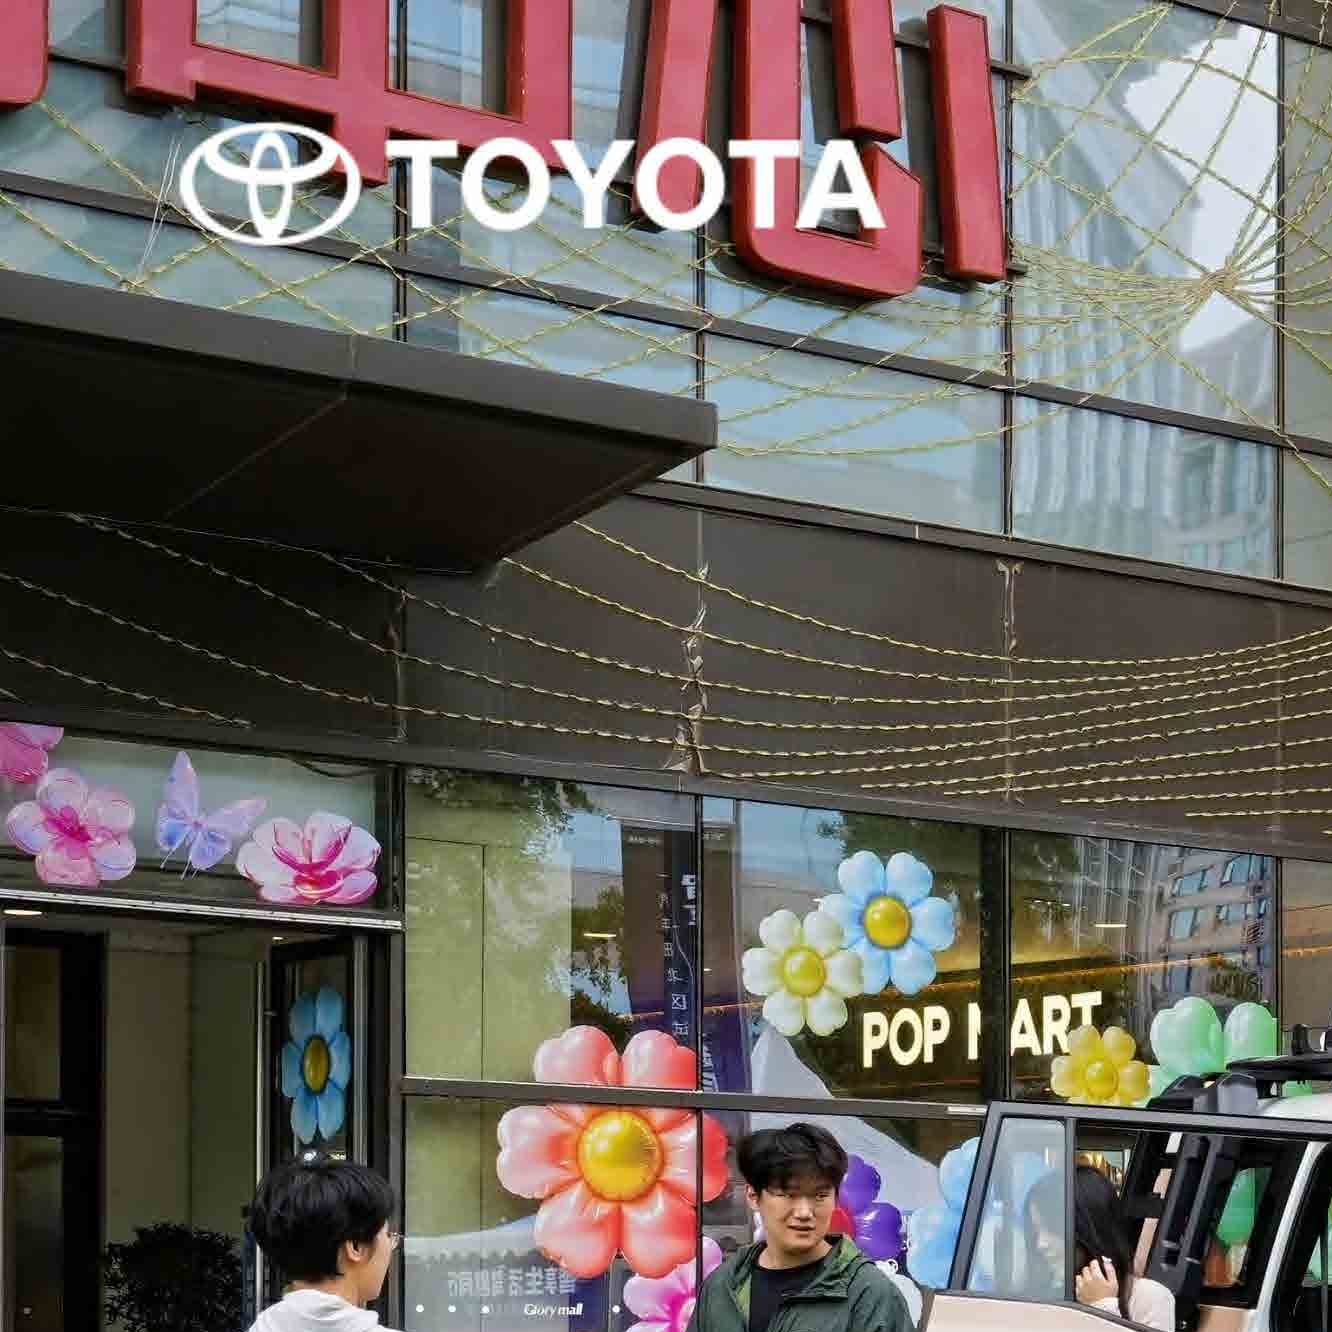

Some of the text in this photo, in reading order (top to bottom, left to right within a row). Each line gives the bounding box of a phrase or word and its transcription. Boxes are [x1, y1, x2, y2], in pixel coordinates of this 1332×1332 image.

[863, 1005, 950, 1068] POP
[523, 1303, 583, 1318] Glory mall
